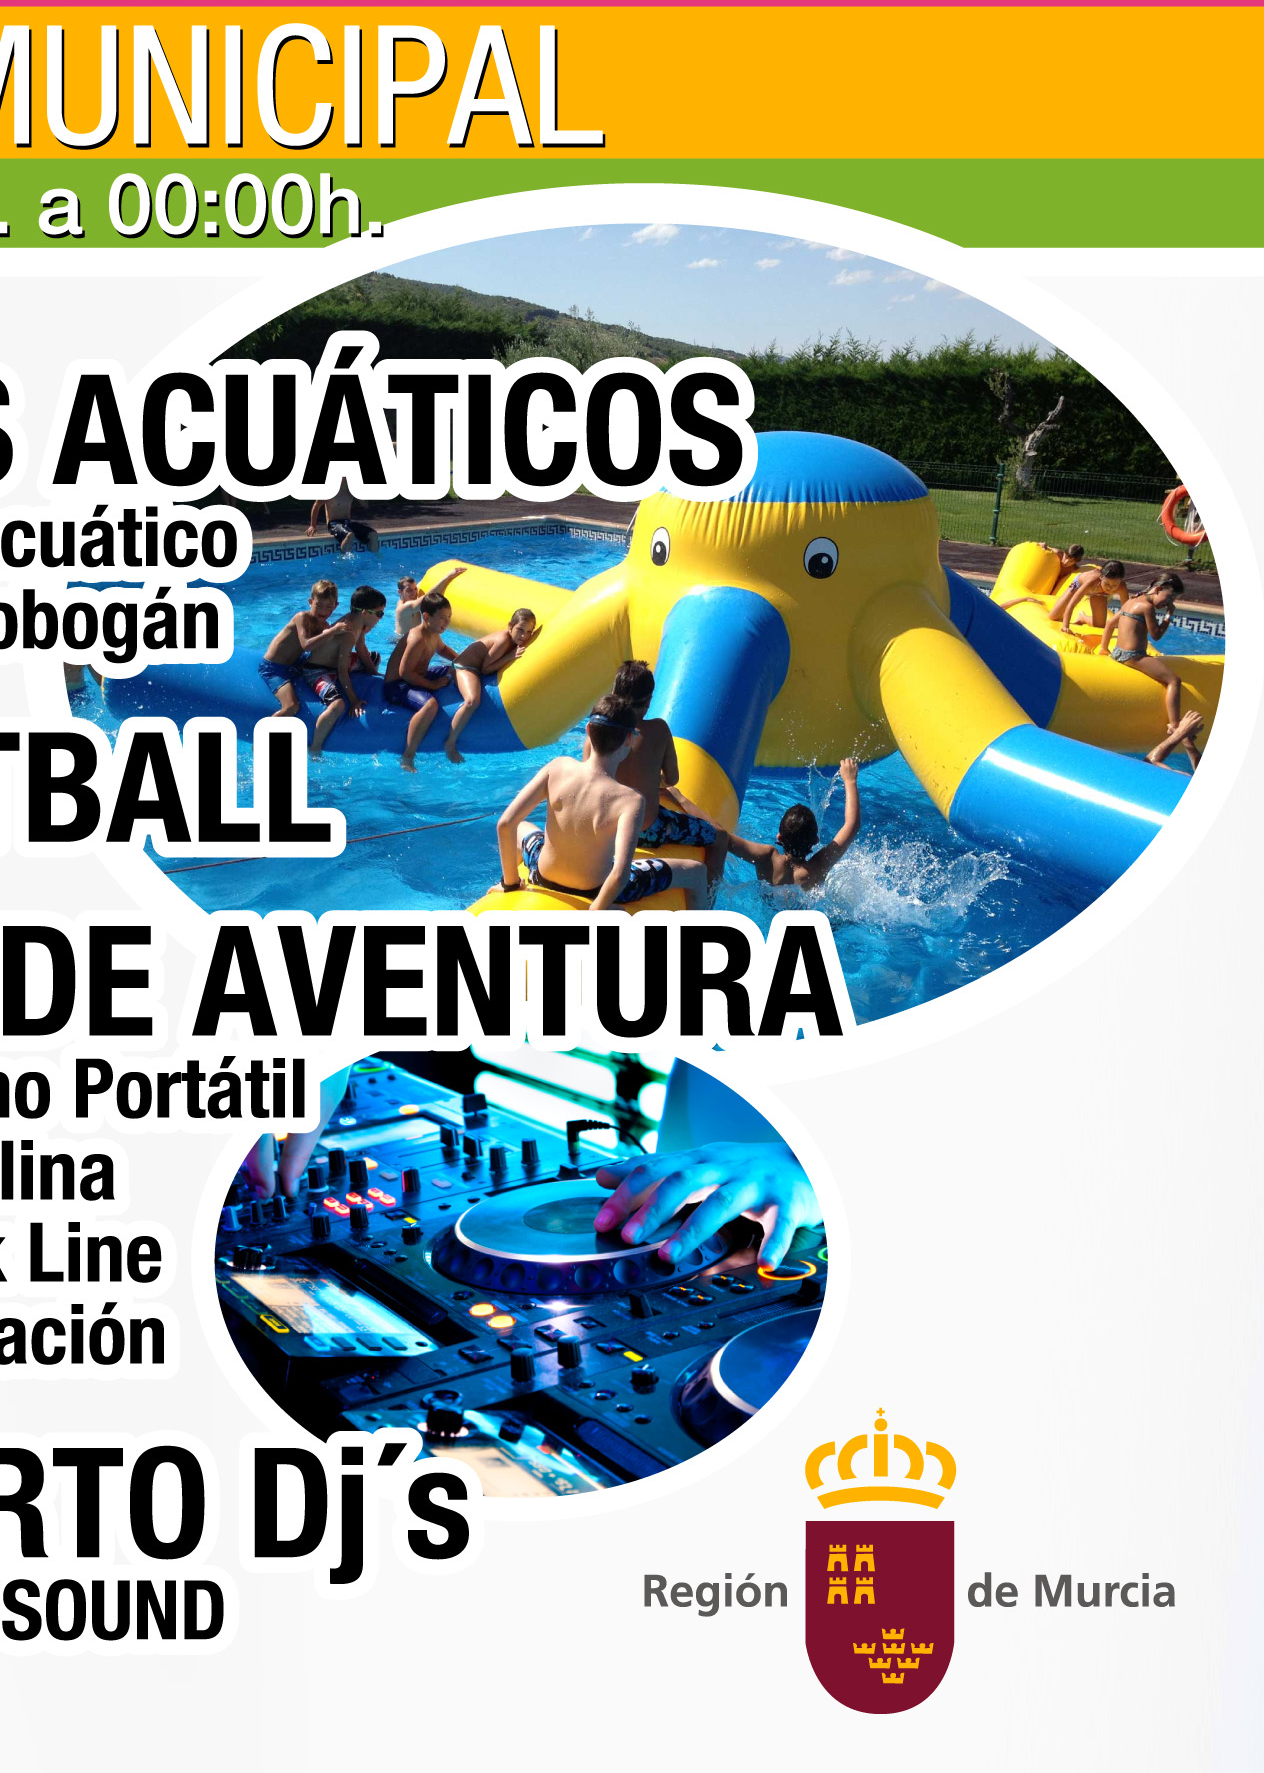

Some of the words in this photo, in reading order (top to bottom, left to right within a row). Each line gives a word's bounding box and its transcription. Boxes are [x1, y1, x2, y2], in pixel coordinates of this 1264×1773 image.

[39, 189, 82, 234] a
[109, 174, 381, 234] 00:00h.
[53, 347, 742, 486] ACUÁTICOS
[3, 926, 152, 1035] DE
[193, 926, 843, 1037] AVENTURA
[76, 1056, 304, 1118] Portátil
[31, 1222, 161, 1283] Line
[3, 1580, 223, 1640] SOUND
[644, 1573, 787, 1617] Región
[968, 1572, 1018, 1607] de
[1035, 1574, 1175, 1607] Murcia
